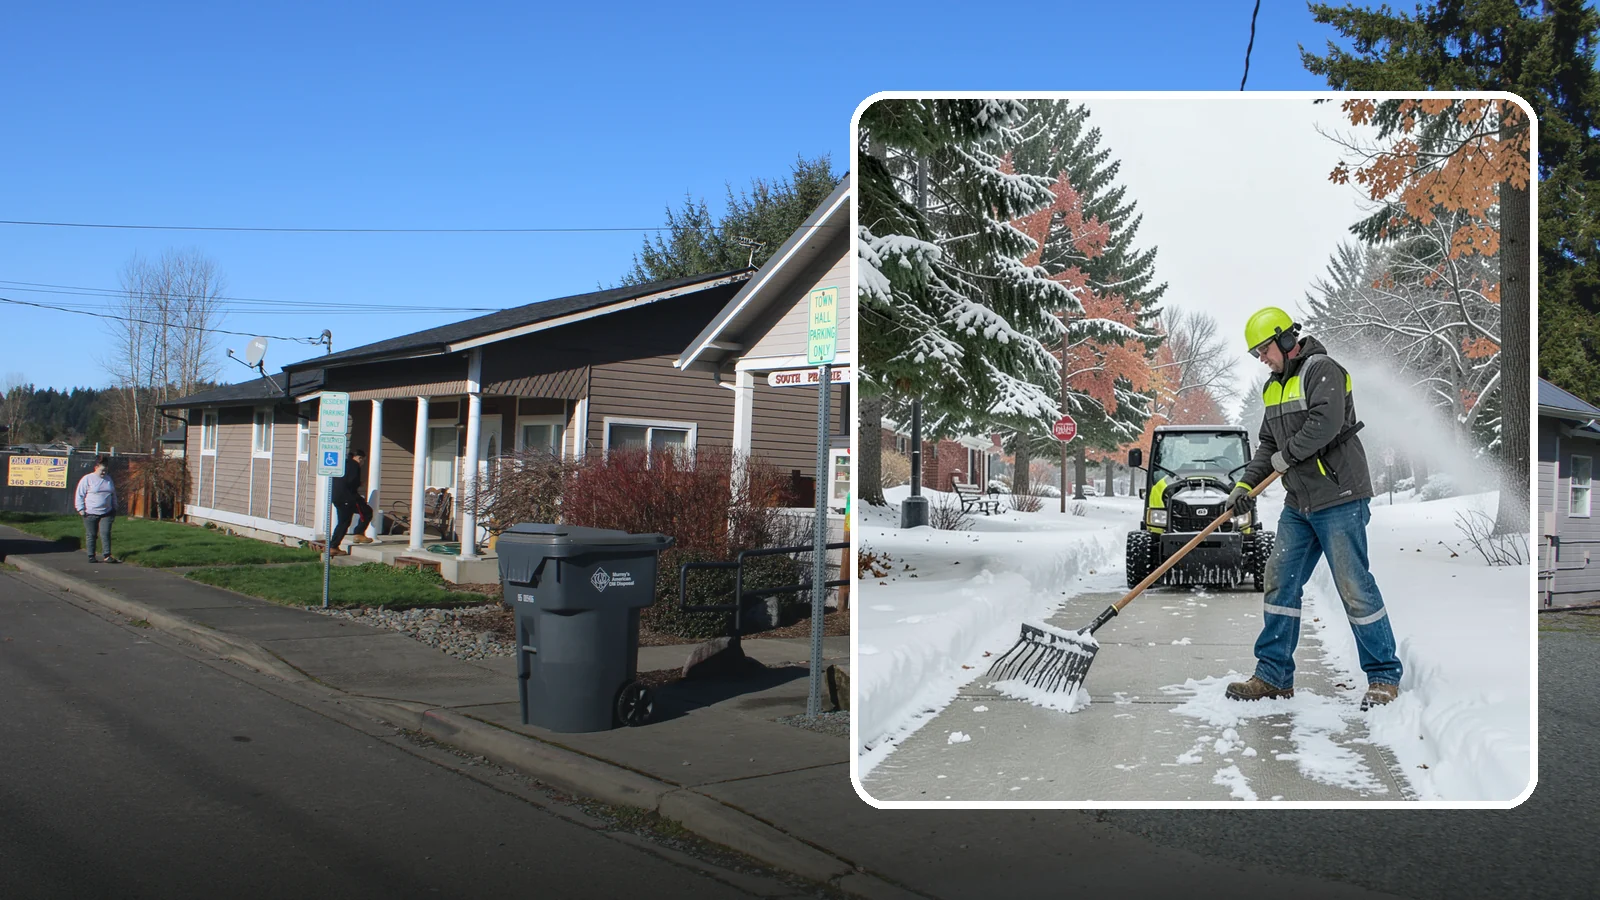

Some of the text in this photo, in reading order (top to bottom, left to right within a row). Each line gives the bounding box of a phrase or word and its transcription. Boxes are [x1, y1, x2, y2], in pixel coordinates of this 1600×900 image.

[815, 294, 833, 308] TOWN
[814, 311, 831, 325] HALL
[810, 326, 836, 341] PARKING
[813, 343, 831, 358] ONLY
[775, 373, 801, 384] SOUTH
